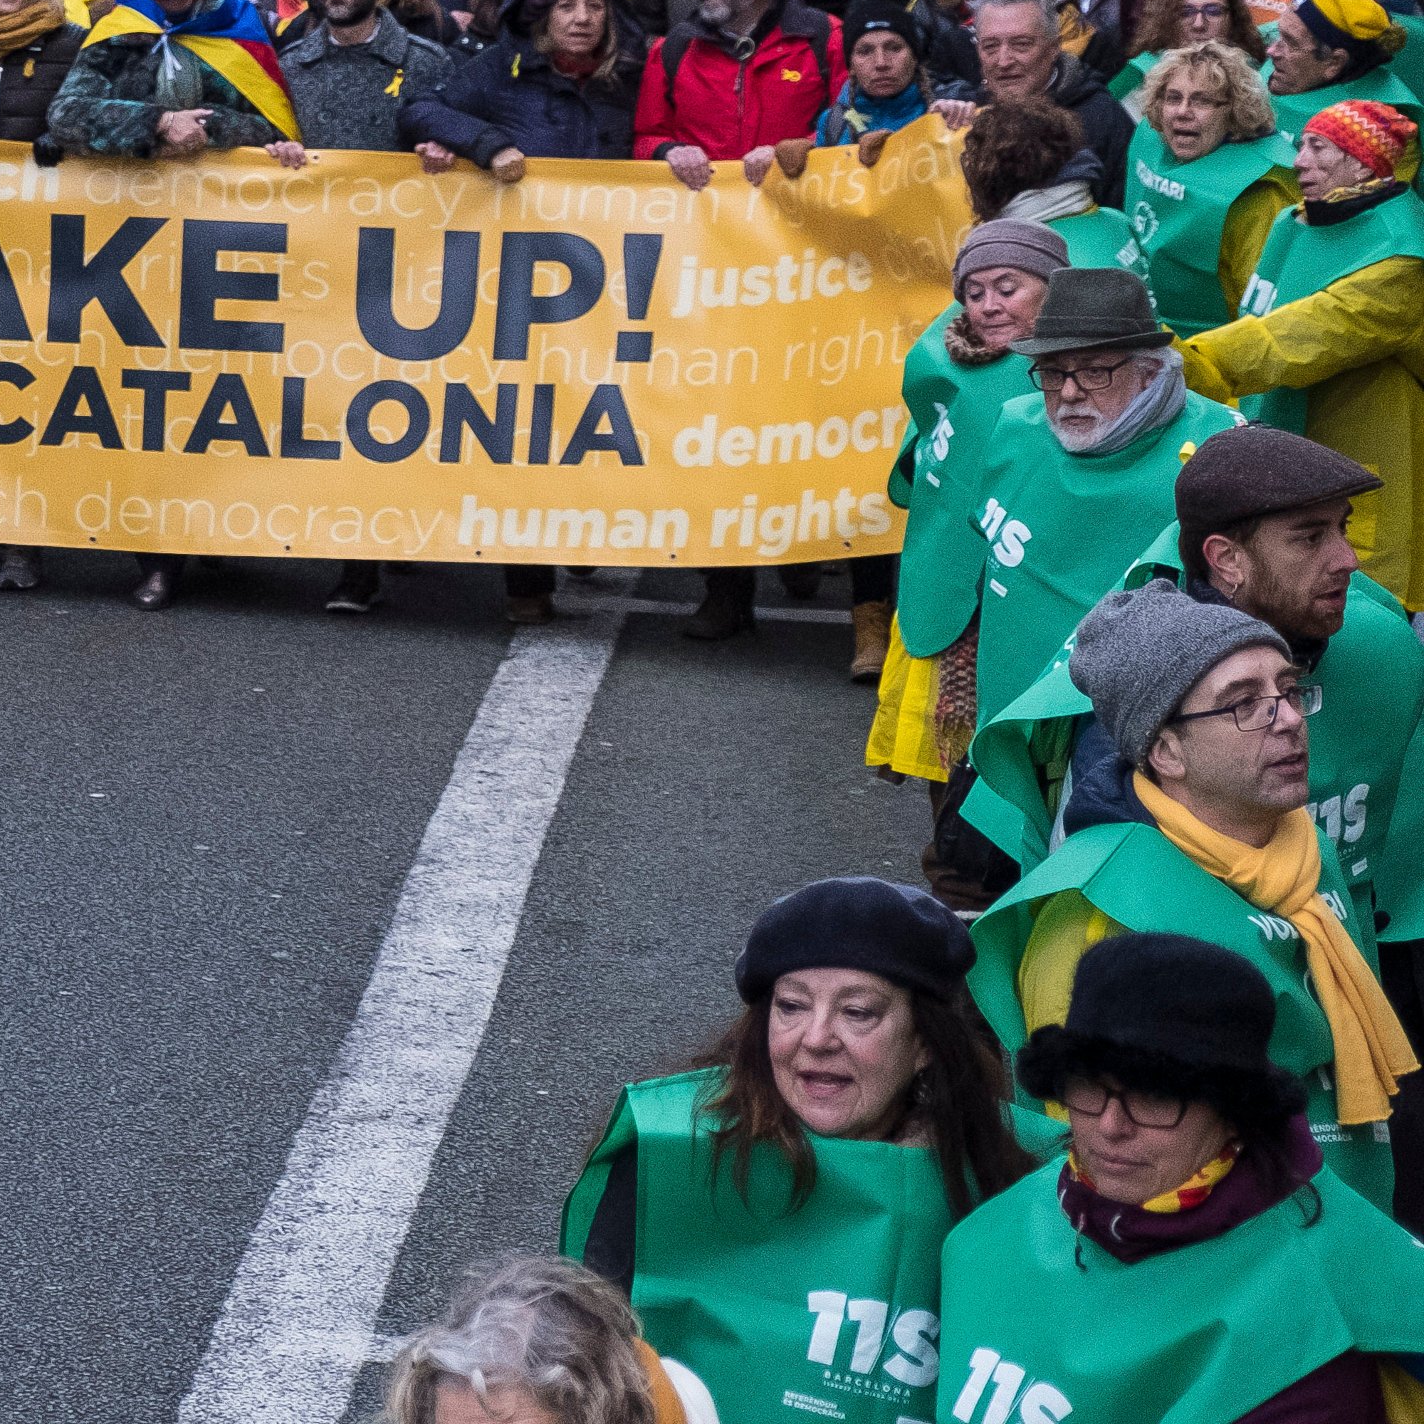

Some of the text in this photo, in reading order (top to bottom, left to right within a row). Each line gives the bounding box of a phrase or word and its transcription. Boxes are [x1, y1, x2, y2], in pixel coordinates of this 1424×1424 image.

[83, 167, 467, 230] democracy
[495, 178, 720, 224] human
[355, 226, 664, 362] UP!
[670, 248, 873, 318] justice
[1239, 272, 1278, 317] 11
[75, 479, 445, 557] democracy
[457, 494, 690, 549] human
[709, 486, 892, 558] rights
[979, 497, 1033, 568] 11S
[823, 1370, 911, 1398] BARCELONA
